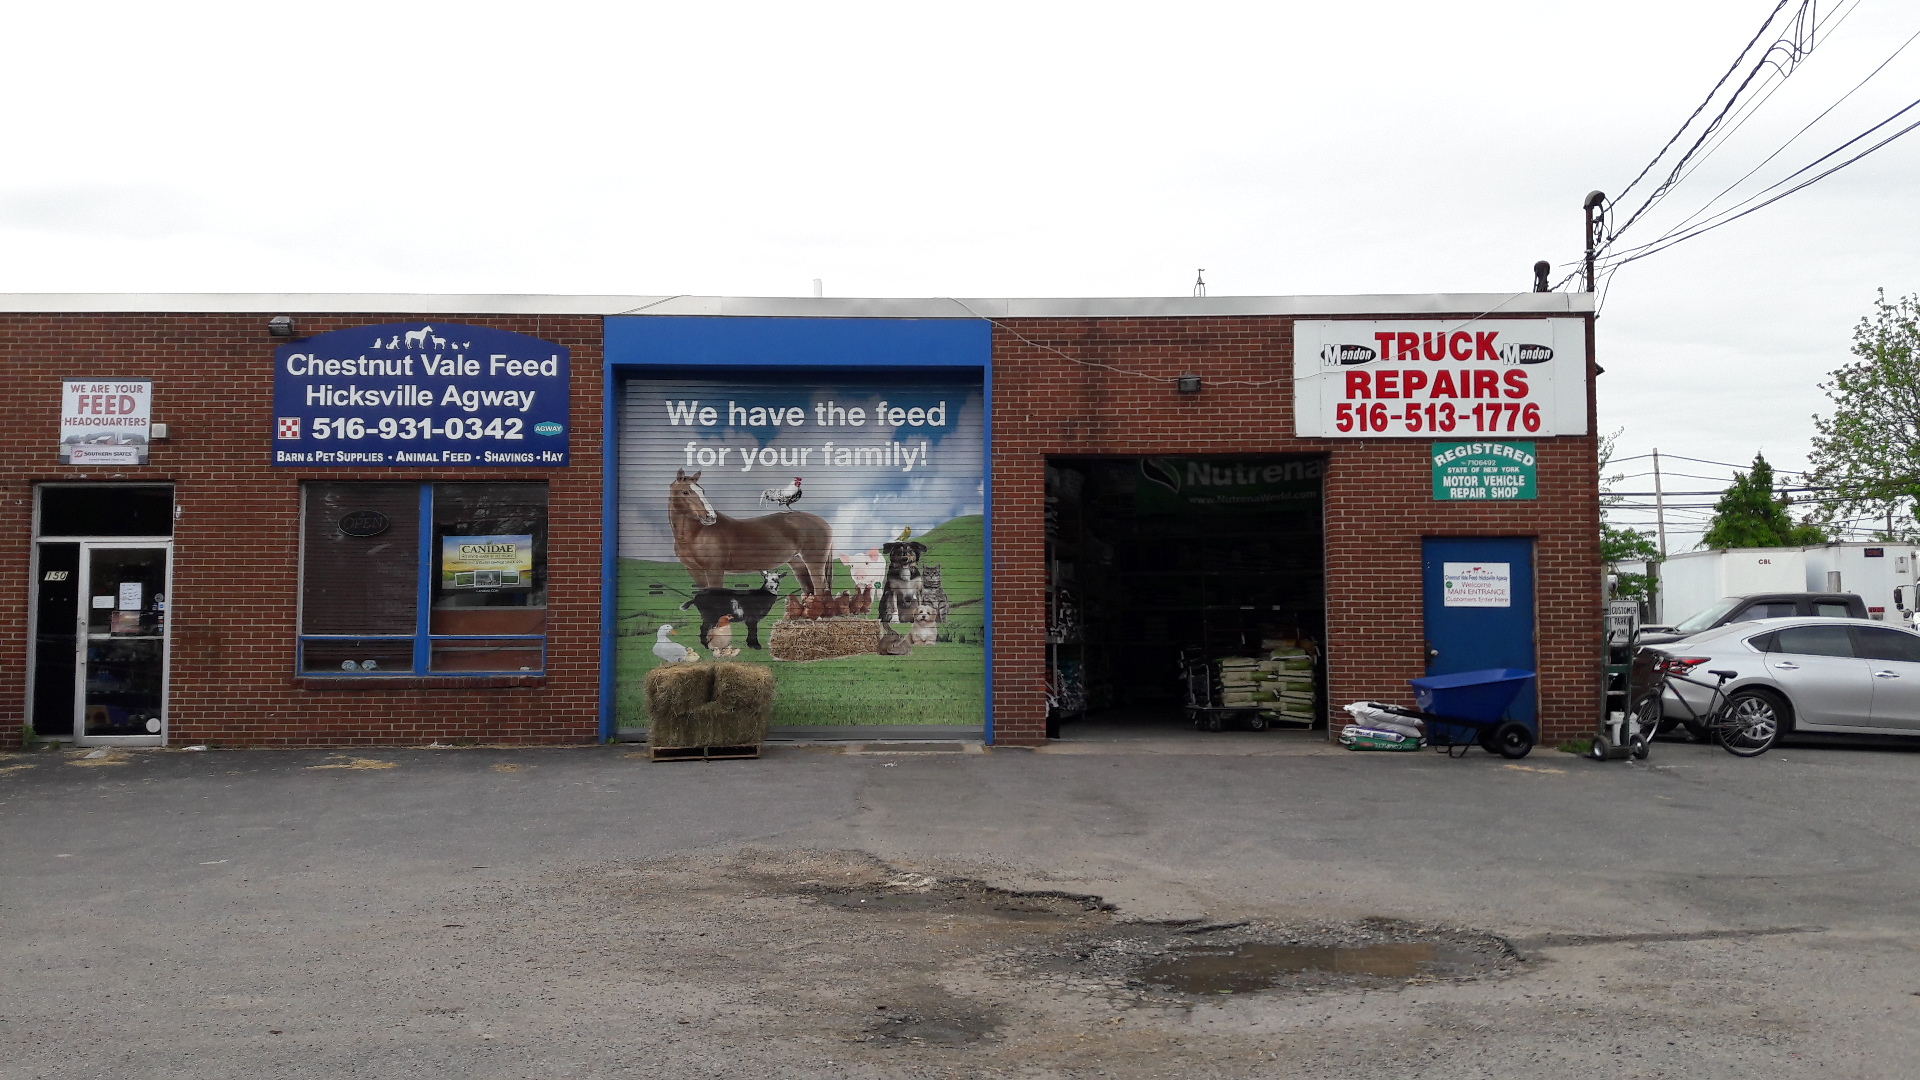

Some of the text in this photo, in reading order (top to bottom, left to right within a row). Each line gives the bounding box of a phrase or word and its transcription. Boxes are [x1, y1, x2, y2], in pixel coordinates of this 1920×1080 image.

[1324, 344, 1371, 366] Mendon
[1375, 331, 1500, 361] TRUCK
[1503, 343, 1551, 365] Mendon
[286, 353, 557, 376] Chestnut Vale Feed
[71, 384, 144, 393] WE ARE YOUR
[1346, 369, 1529, 399] REPAIRS
[77, 394, 136, 415] FEED
[306, 384, 535, 411] Hicksville Agway
[64, 417, 147, 427] HEADQUARTERS
[665, 400, 946, 426] We have the feed
[1336, 402, 1541, 432] 516-513-1776
[311, 417, 523, 440] 516-931-0342
[306, 453, 313, 461] &
[684, 441, 927, 472] for your family!
[1434, 443, 1535, 467] REGISTERED
[1187, 460, 1322, 485] Nutrena
[1443, 475, 1525, 486] MOTOR VEHICLE
[1450, 487, 1519, 498] REPAIR SHOP
[343, 517, 383, 529] OPEN
[461, 545, 514, 553] CANIDAE
[47, 571, 68, 580] 150
[1611, 606, 1637, 615] CUSTOMER
